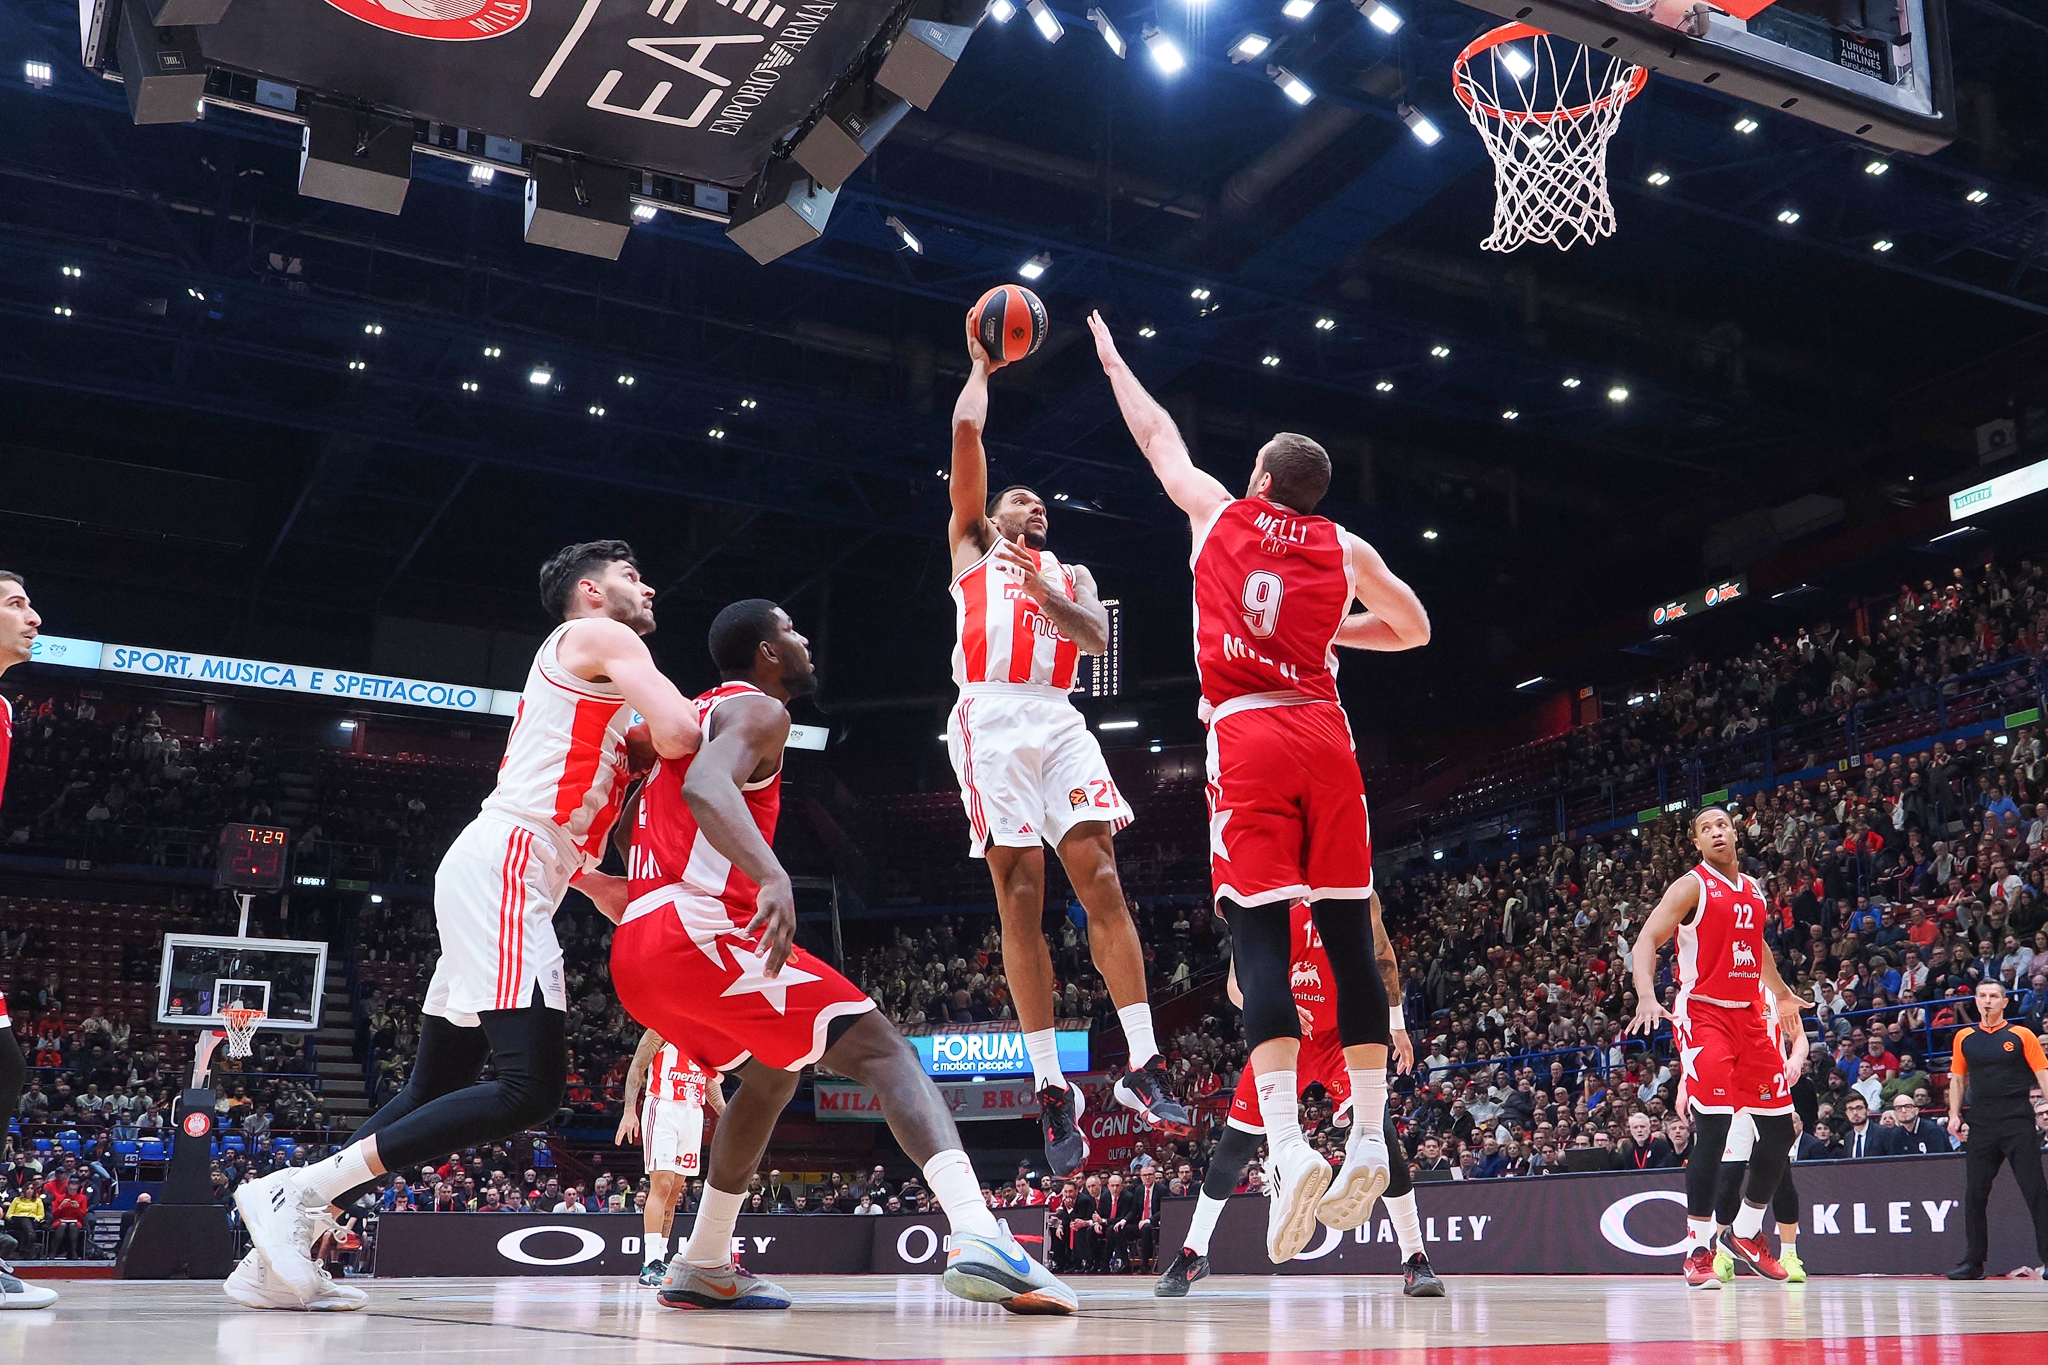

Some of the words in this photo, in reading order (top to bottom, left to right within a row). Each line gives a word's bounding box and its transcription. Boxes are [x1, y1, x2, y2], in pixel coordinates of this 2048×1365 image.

[468, 0, 522, 34] MILA
[1840, 38, 1880, 60] TURKISH
[1840, 50, 1881, 71] AIRLINES
[708, 69, 781, 136] EMPORIO
[775, 0, 838, 53] ARMA
[1841, 58, 1883, 79] EuroLeague
[1957, 488, 1990, 507] ULIVETO
[1253, 511, 1307, 544] MELLI
[1241, 570, 1284, 640] 9
[112, 648, 194, 678] SPORT,
[200, 659, 297, 688] MUSICA
[310, 671, 323, 690] E
[333, 674, 477, 708] SPETTACOLO
[1089, 779, 1120, 809] 21
[1669, 801, 1682, 812] BAR
[247, 829, 284, 844] 7:29
[302, 877, 320, 886] BAR
[1733, 903, 1754, 929] 22
[1728, 970, 1759, 979] plenitude
[932, 1034, 1024, 1062] FORUM
[941, 1061, 976, 1072] motion
[977, 1061, 1014, 1073] people
[819, 1091, 882, 1112] MILA
[1091, 1112, 1129, 1139] CANI
[1774, 1200, 1953, 1235] KLEY
[1354, 1216, 1488, 1244] OALEY
[621, 1236, 772, 1255] OEY
